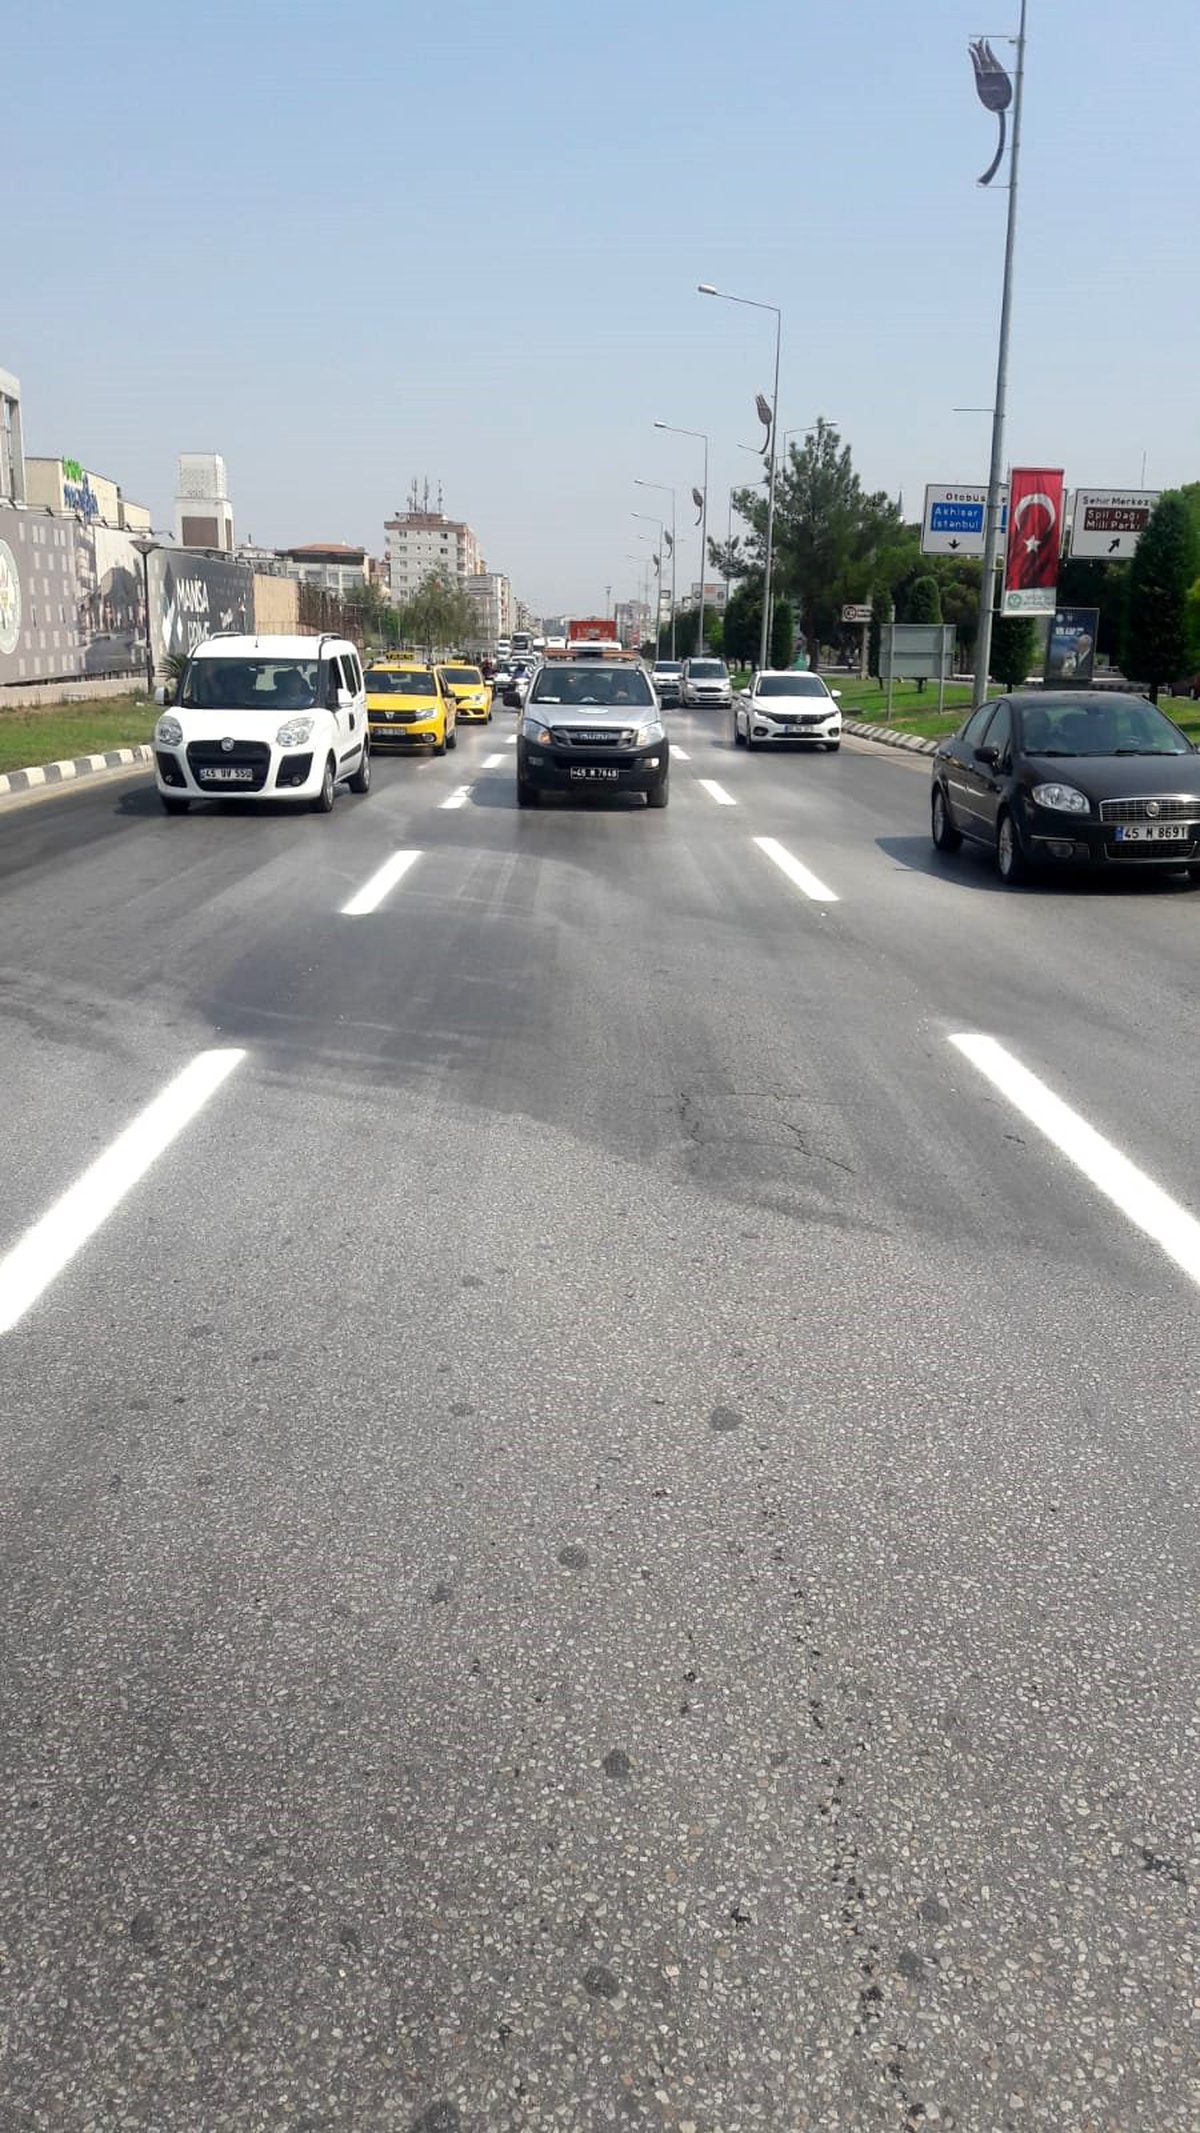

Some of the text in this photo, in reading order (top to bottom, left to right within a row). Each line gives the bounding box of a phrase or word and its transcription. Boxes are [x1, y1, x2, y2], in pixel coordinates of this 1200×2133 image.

[935, 506, 978, 517] Akhisar
[1124, 827, 1140, 839] 45
[1158, 827, 1185, 839] 8691
